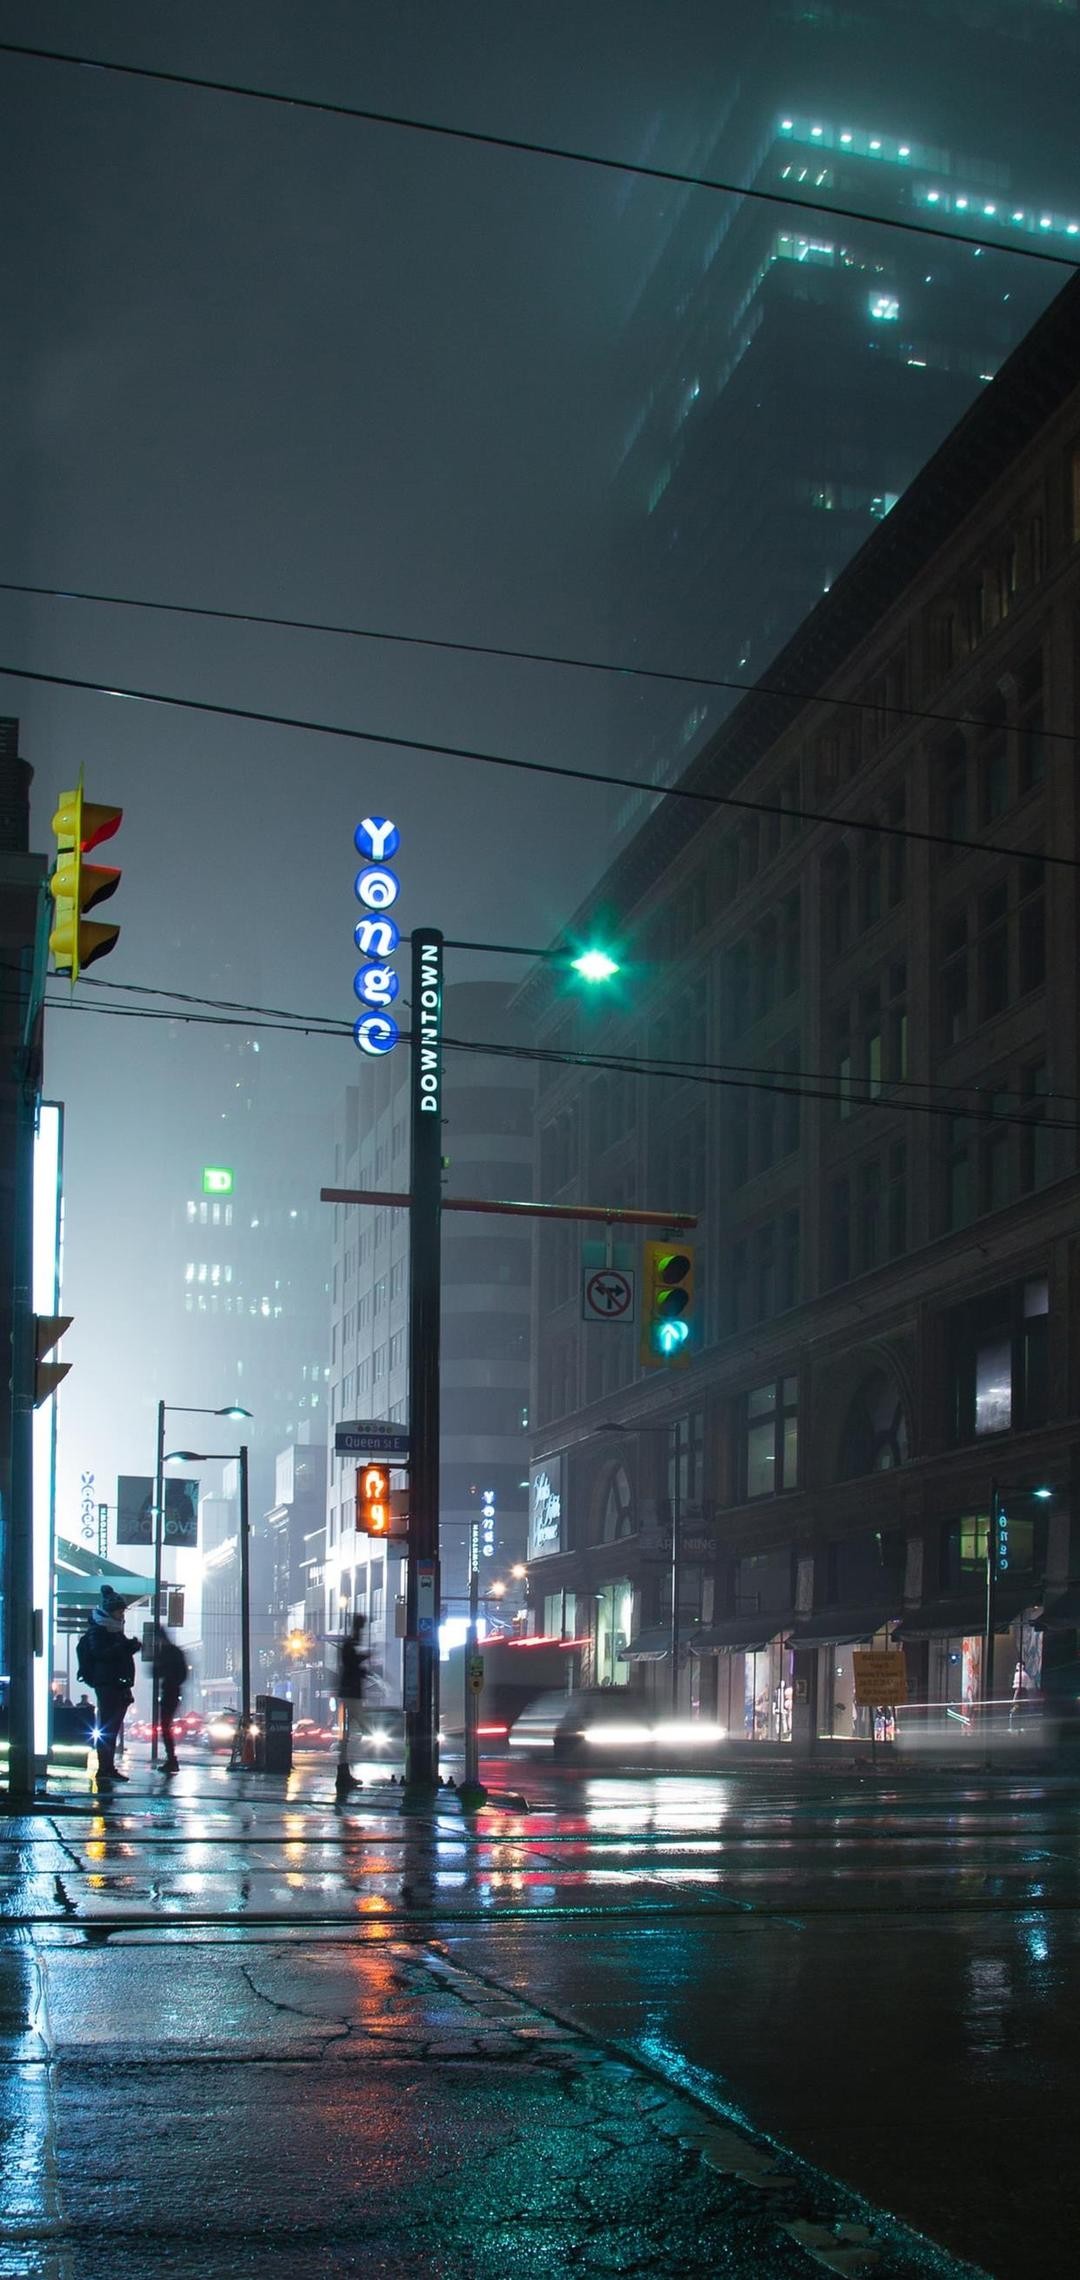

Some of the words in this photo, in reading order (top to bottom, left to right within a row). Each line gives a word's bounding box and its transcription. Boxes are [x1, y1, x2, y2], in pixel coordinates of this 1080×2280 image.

[355, 817, 397, 1055] Yonge
[421, 945, 438, 1112] DOWNTOWN
[345, 1436, 380, 1448] Queen
[394, 1437, 401, 1448] E
